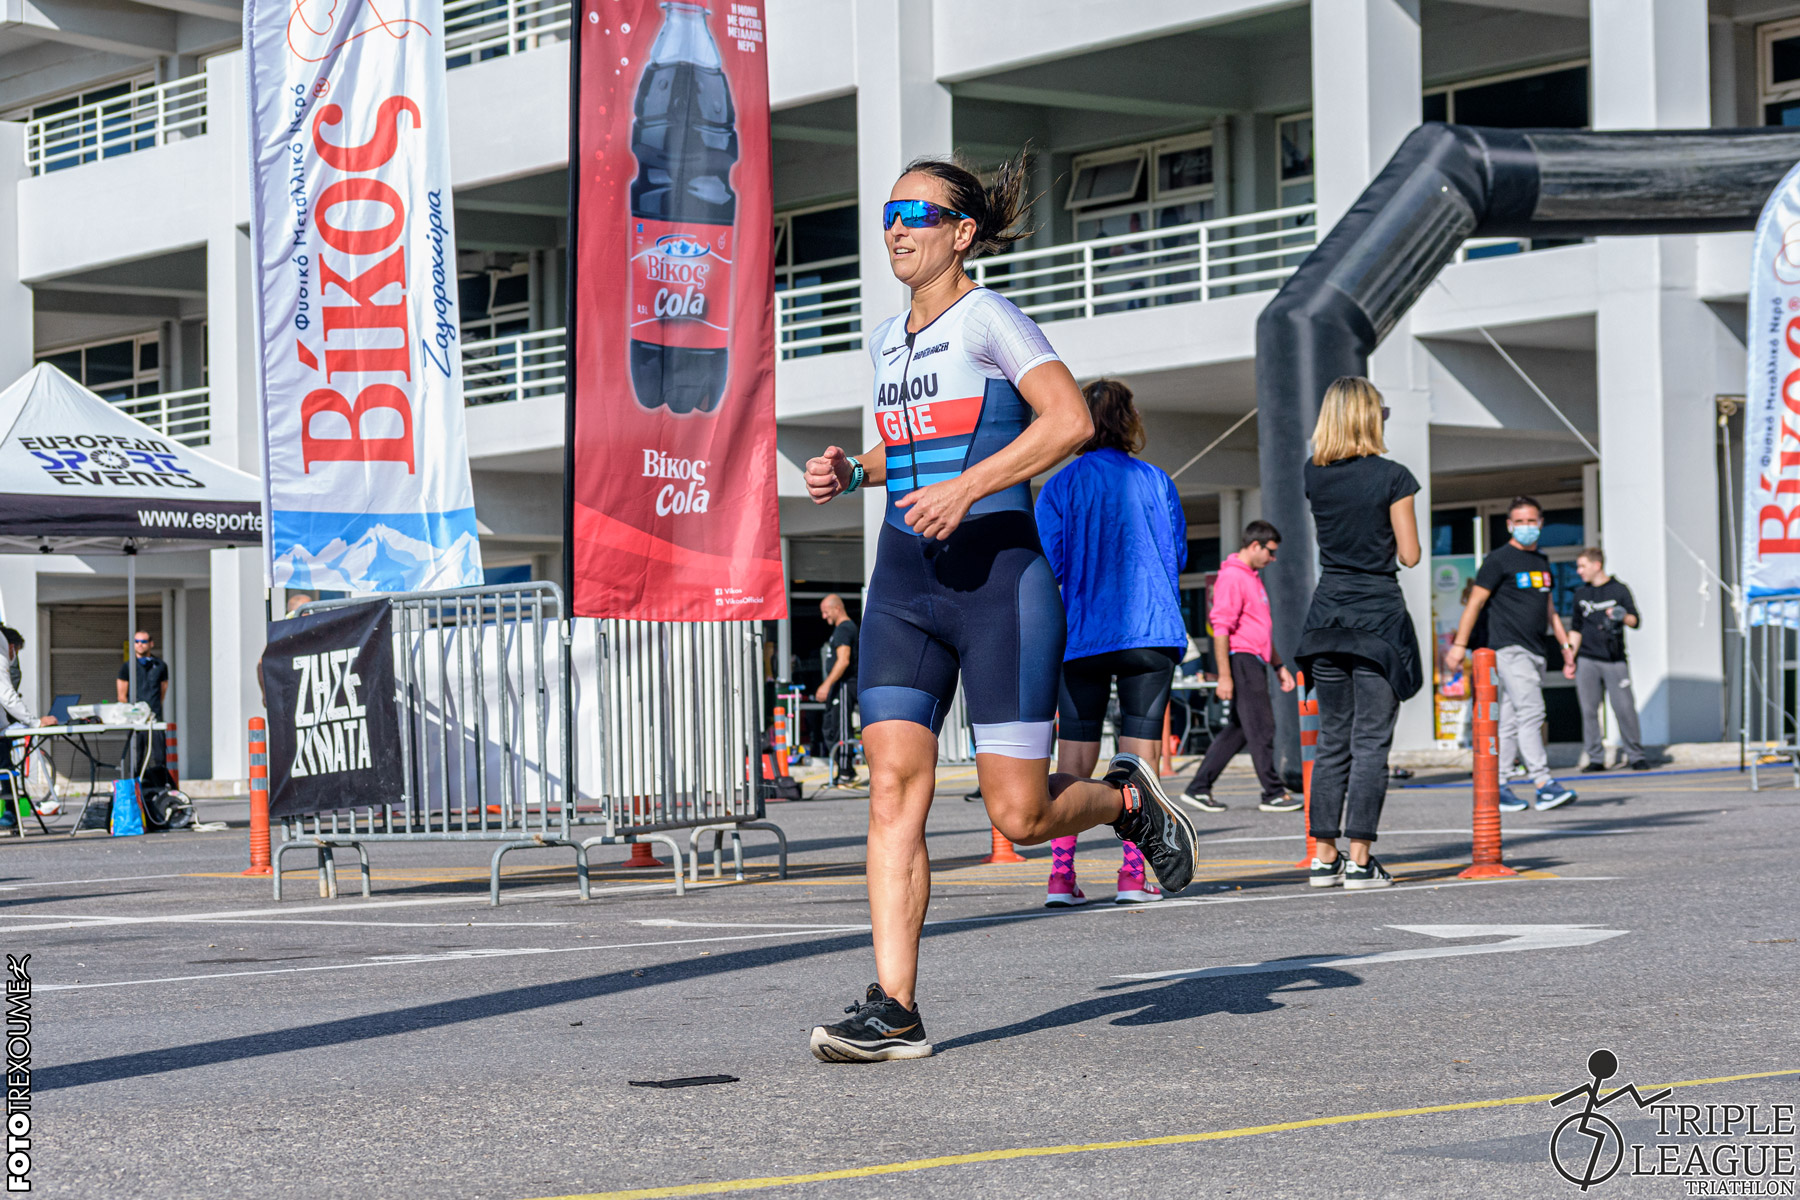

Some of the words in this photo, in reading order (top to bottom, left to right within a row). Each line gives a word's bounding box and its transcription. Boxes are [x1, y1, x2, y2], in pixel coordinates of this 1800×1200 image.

[290, 83, 306, 133] Νερό
[288, 142, 307, 246] Μεταλλικό
[292, 255, 310, 330] Φυσικό
[654, 285, 705, 317] Cola
[883, 404, 936, 441] GRE
[642, 449, 706, 486] Βίκος
[656, 481, 710, 517] Cola
[725, 596, 764, 605] VikosOfficial
